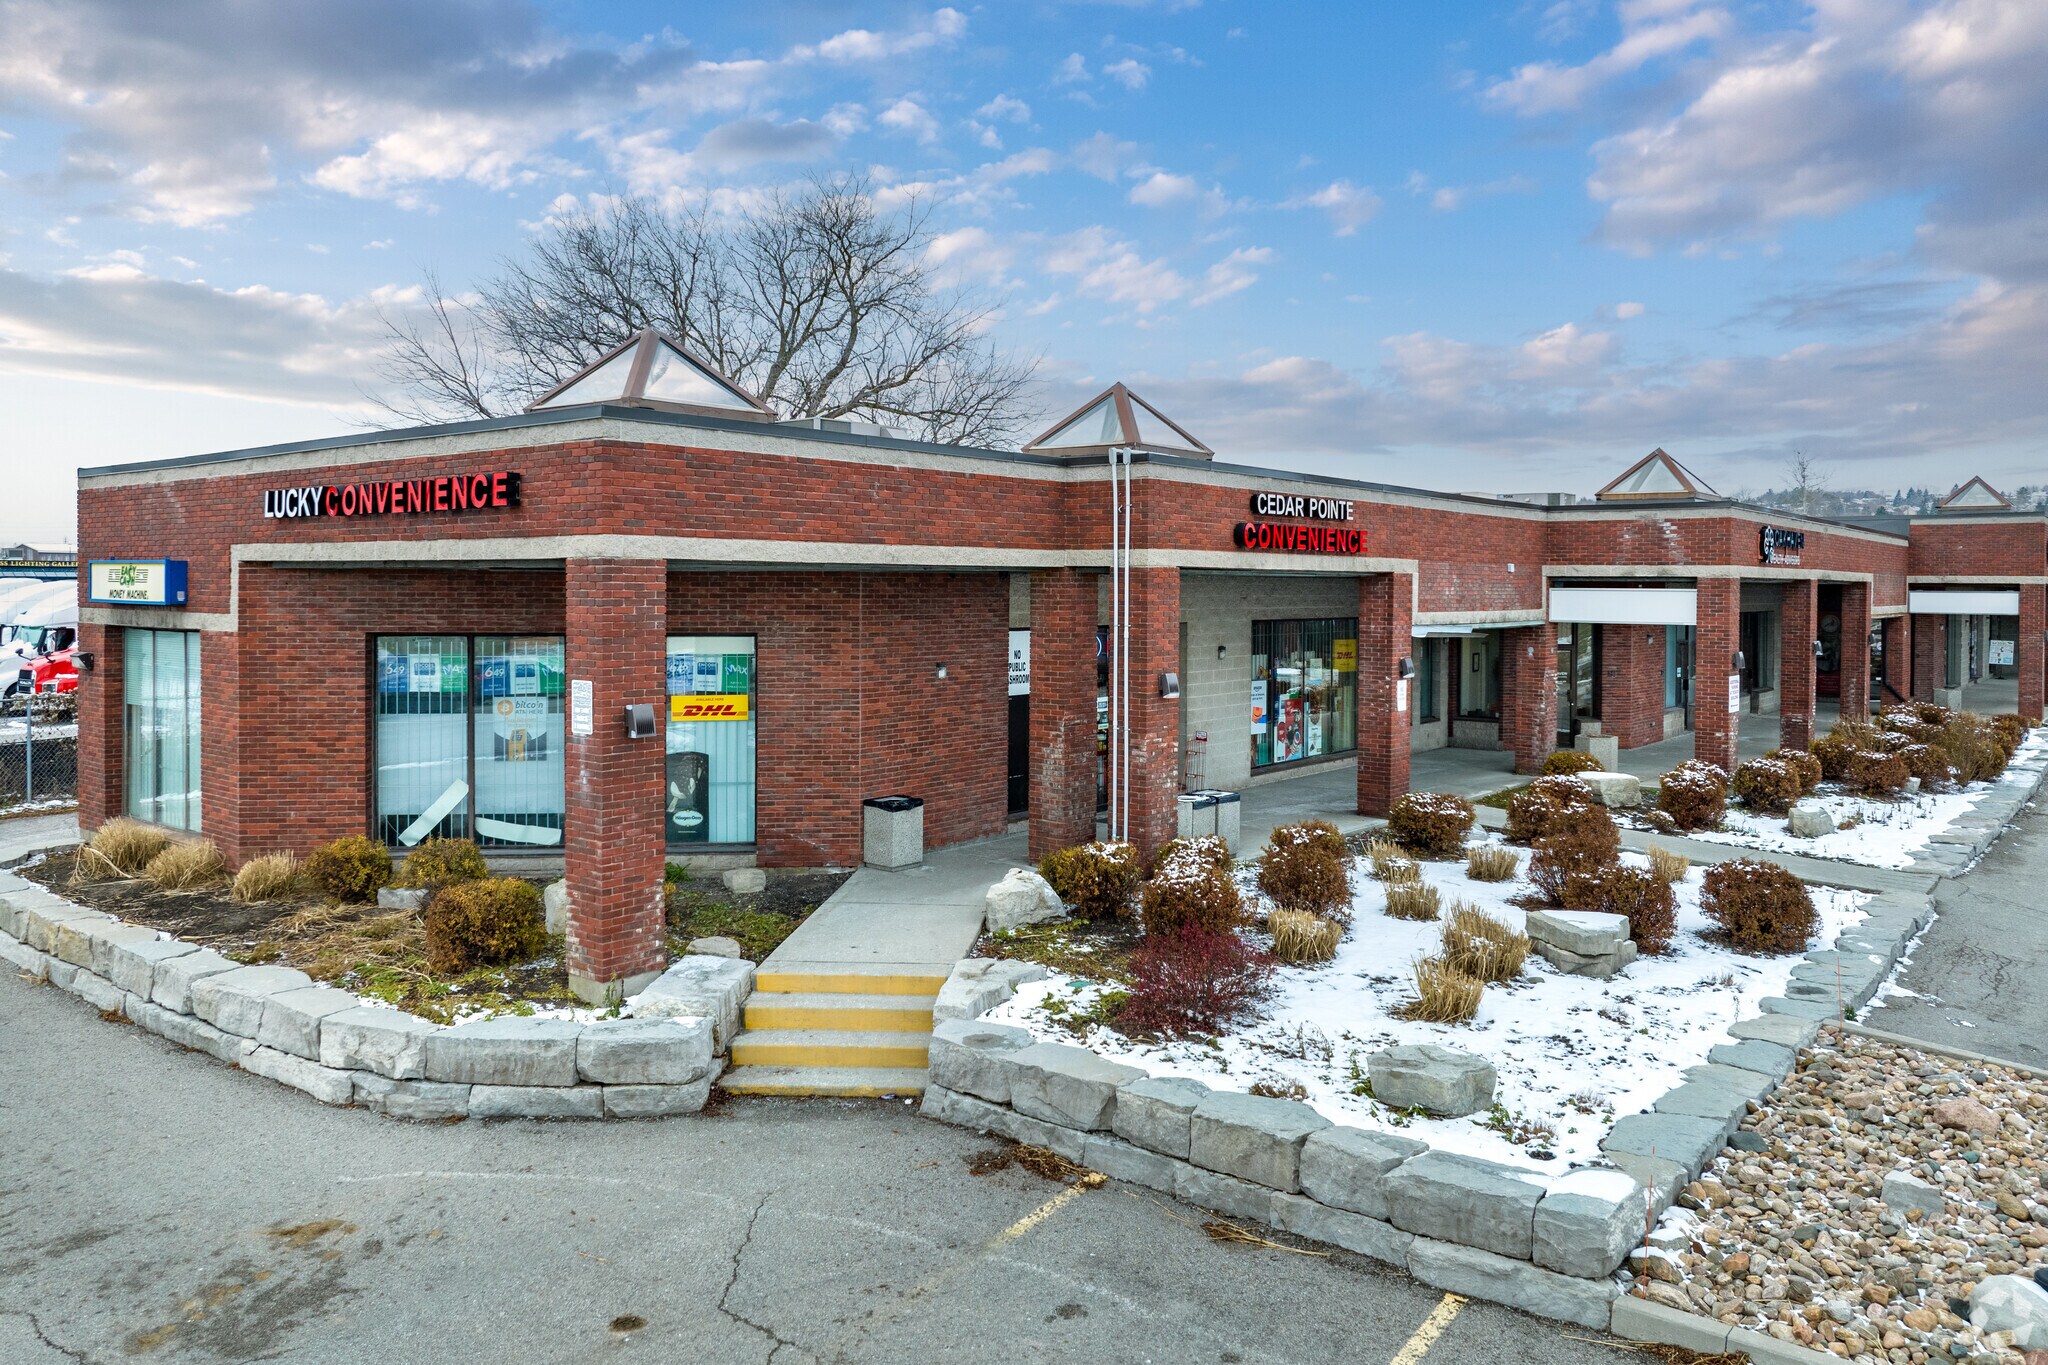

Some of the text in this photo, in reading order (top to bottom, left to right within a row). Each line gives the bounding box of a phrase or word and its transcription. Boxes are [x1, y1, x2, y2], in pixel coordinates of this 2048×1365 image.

[264, 471, 508, 518] LUCKY CONVENIENCE
[1257, 493, 1354, 520] CEDAR POINTE
[1244, 522, 1368, 553] CONVENIENCE
[109, 589, 125, 598] MONEY
[1014, 650, 1021, 660] NO
[484, 666, 504, 677] 649
[725, 664, 748, 675] MAX
[1008, 661, 1026, 672] PUBLIC
[516, 700, 543, 709] bitcoin
[682, 704, 738, 717] DHL
